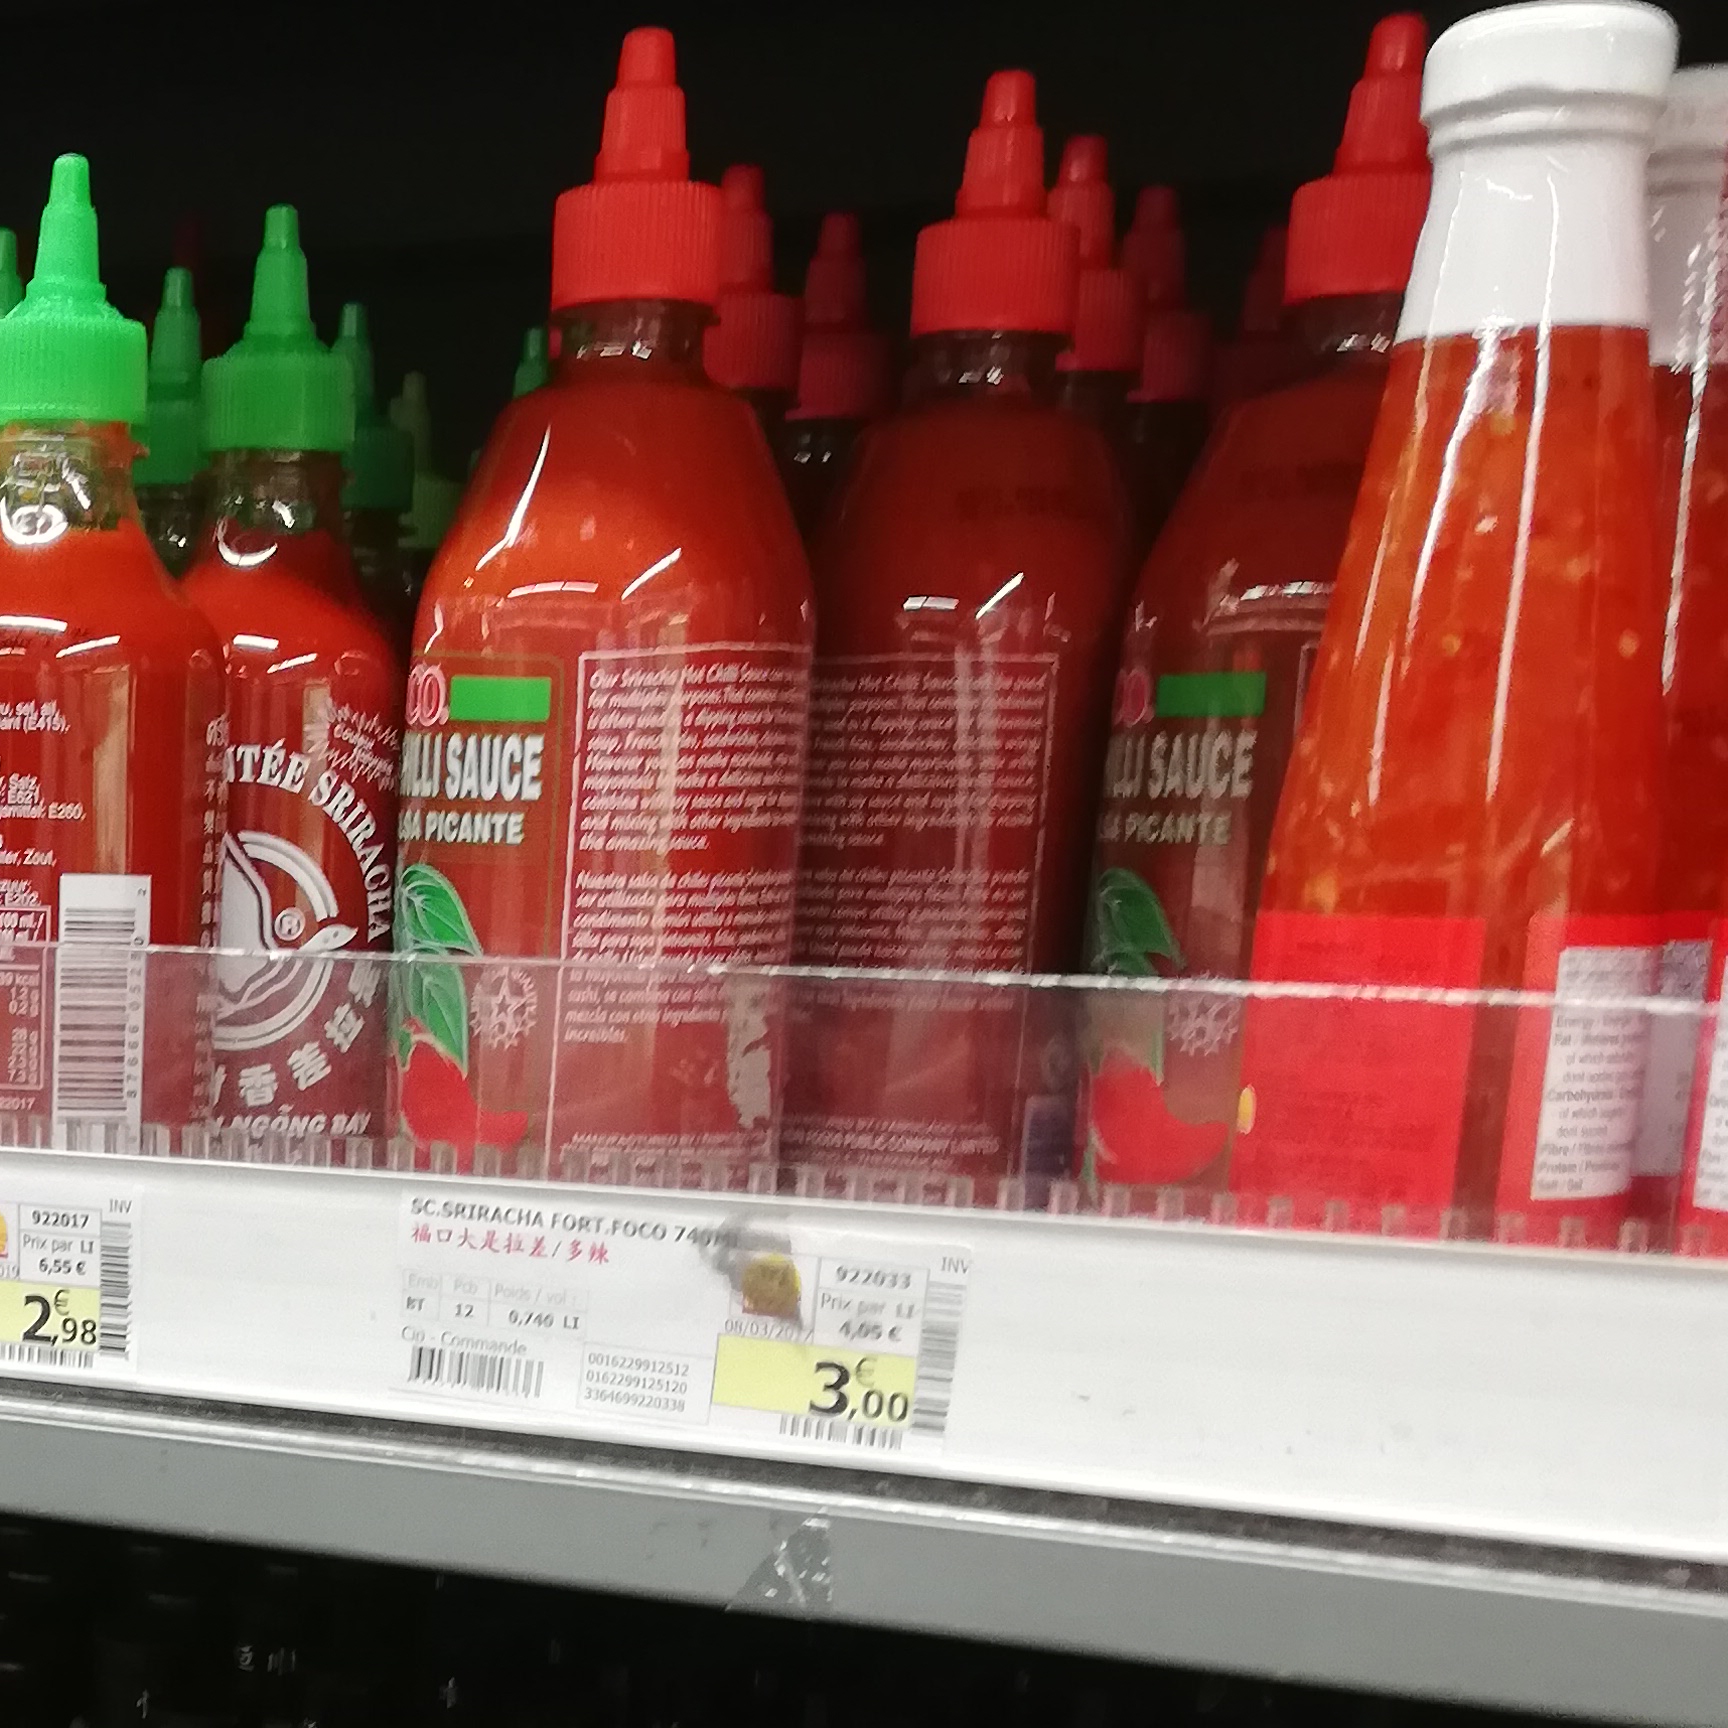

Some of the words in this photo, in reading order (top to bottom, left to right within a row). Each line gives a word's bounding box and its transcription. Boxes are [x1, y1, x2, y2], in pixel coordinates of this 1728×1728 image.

[445, 732, 545, 802] SAUCE
[424, 810, 525, 845] PICANTE
[308, 769, 392, 944] SRIRACHA
[31, 1209, 90, 1229] 922017
[410, 1198, 545, 1229] SC.SRIRACHA
[551, 1211, 667, 1241] FORT.FOCO
[53, 1288, 71, 1316] €
[454, 1303, 474, 1318] 12
